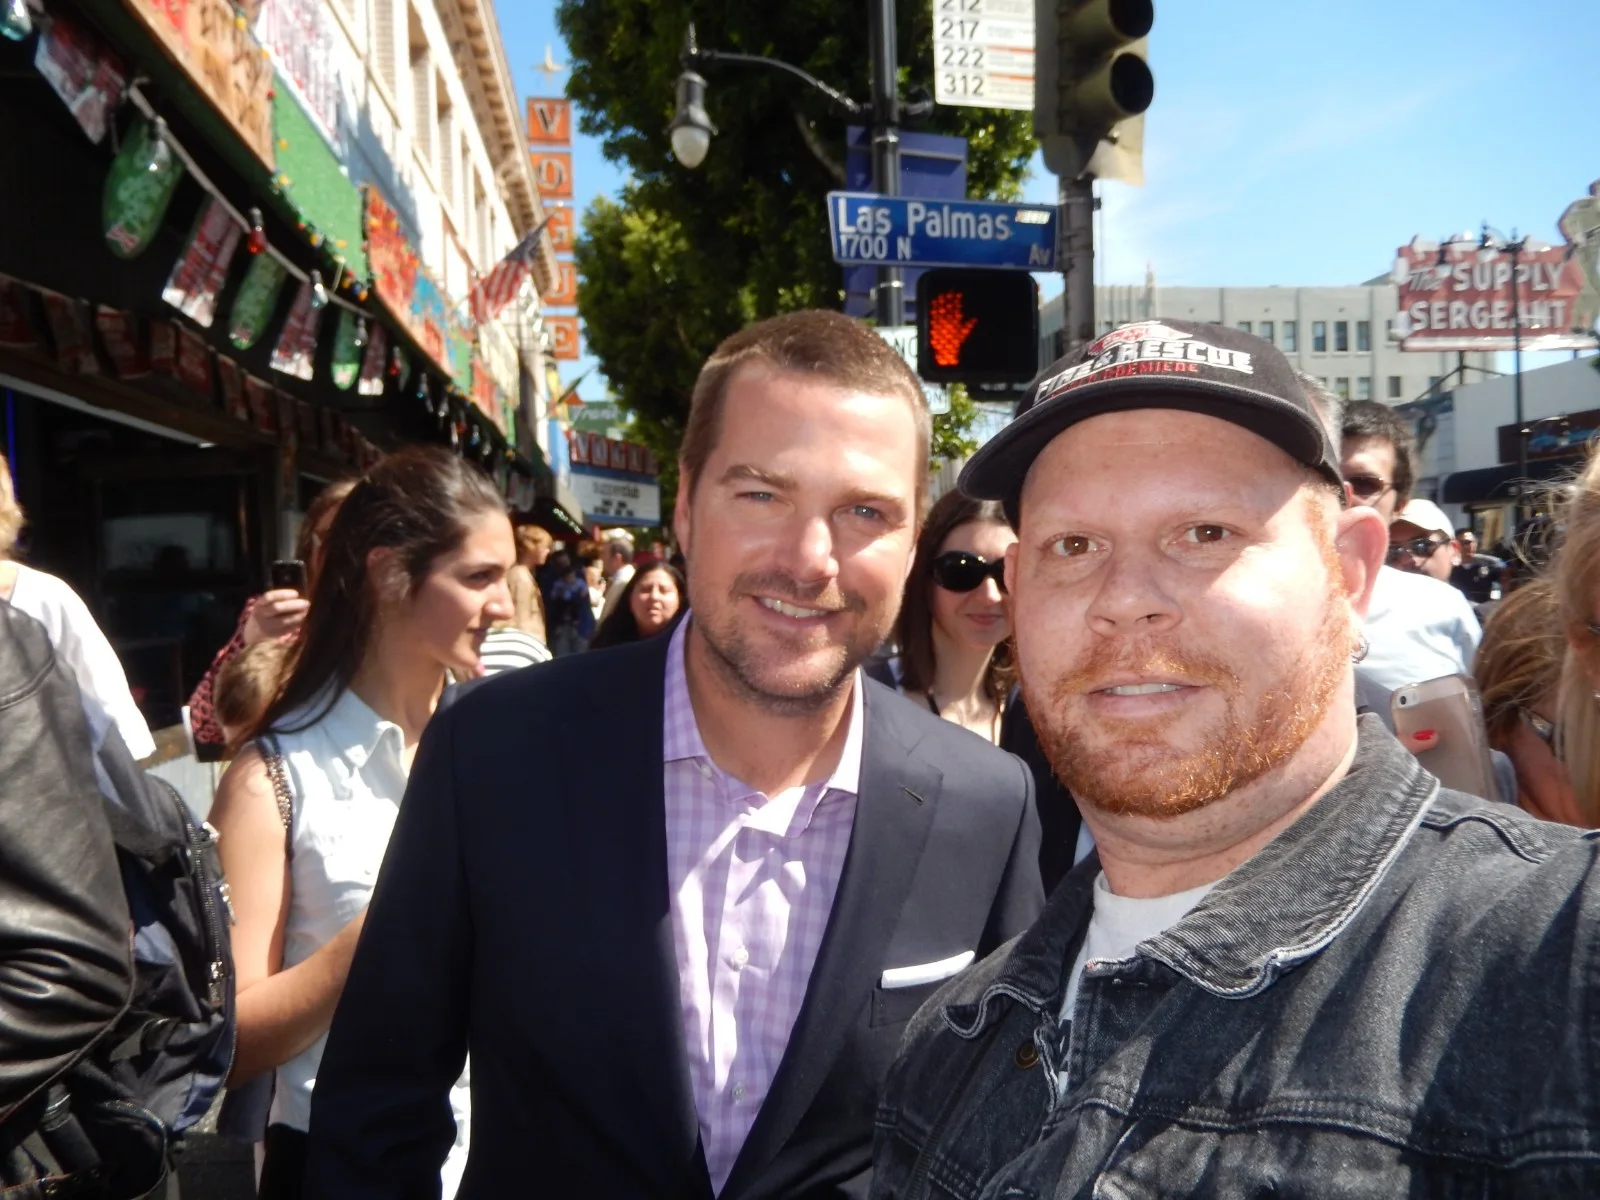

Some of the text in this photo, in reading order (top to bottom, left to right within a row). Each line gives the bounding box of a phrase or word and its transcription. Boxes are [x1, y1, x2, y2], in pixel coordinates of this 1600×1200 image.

[941, 18, 980, 40] 217
[942, 45, 984, 68] 222
[944, 74, 984, 96] 312
[838, 197, 1010, 241] Las Palmas
[840, 233, 1051, 266] 1700 N Av
[1452, 262, 1566, 292] SUPPLY
[1409, 300, 1567, 330] SERGEANT
[1116, 338, 1254, 376] RESCUE
